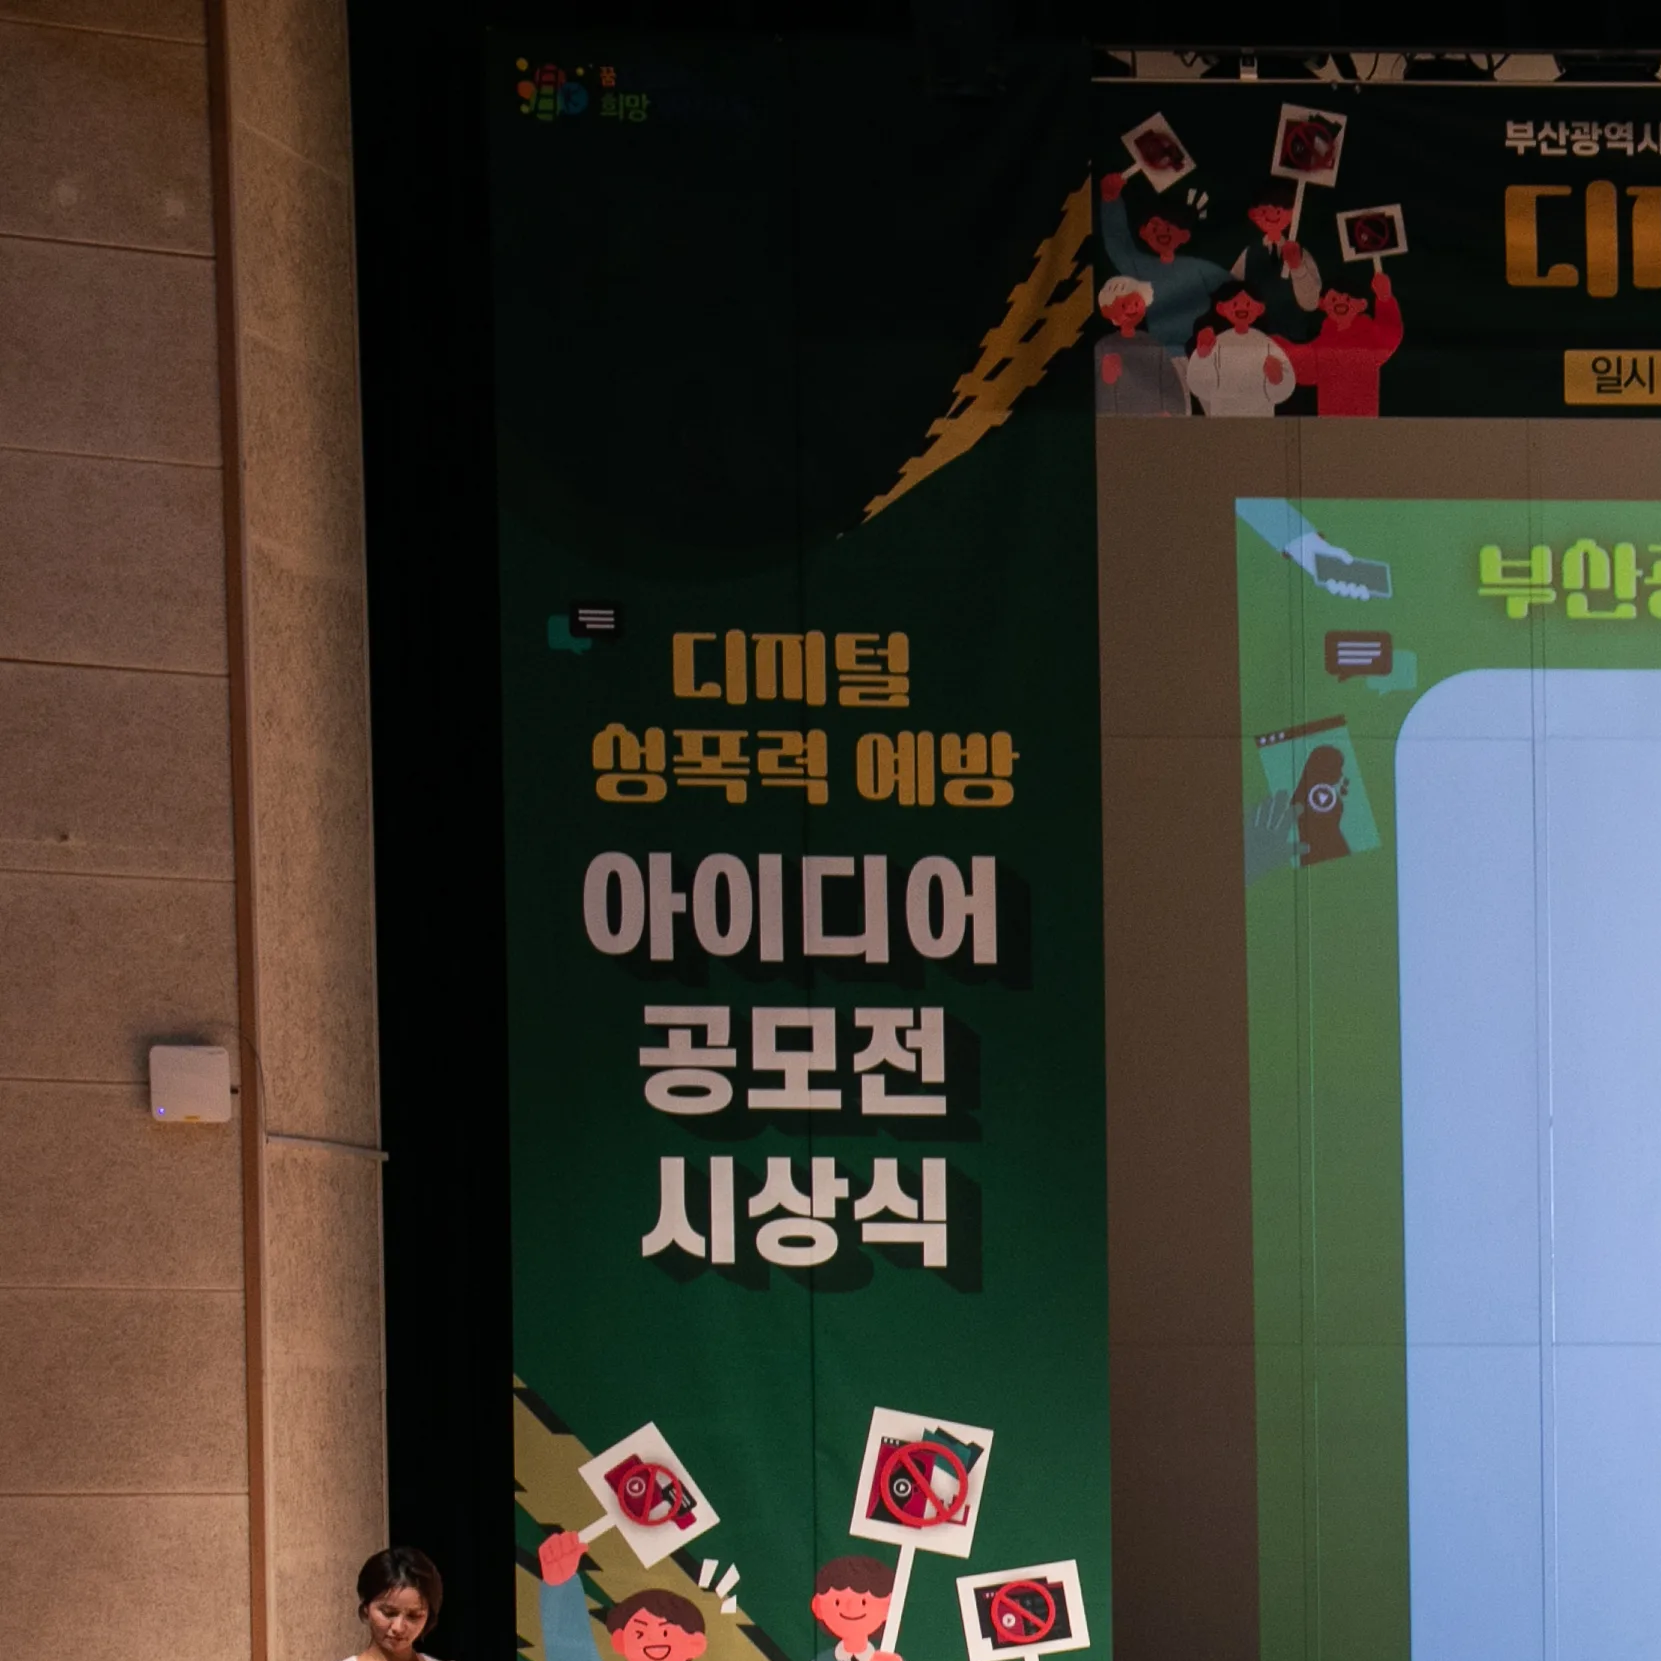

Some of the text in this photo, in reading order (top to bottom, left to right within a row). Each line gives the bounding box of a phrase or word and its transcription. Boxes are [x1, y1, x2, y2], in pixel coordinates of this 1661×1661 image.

[1590, 356, 1656, 397] 일시
[671, 628, 911, 708] 디지털
[592, 722, 1021, 808] 성폭력 예방
[582, 851, 999, 966] 아이디어
[638, 1004, 948, 1116] 공모전
[641, 1155, 949, 1268] 시상식
